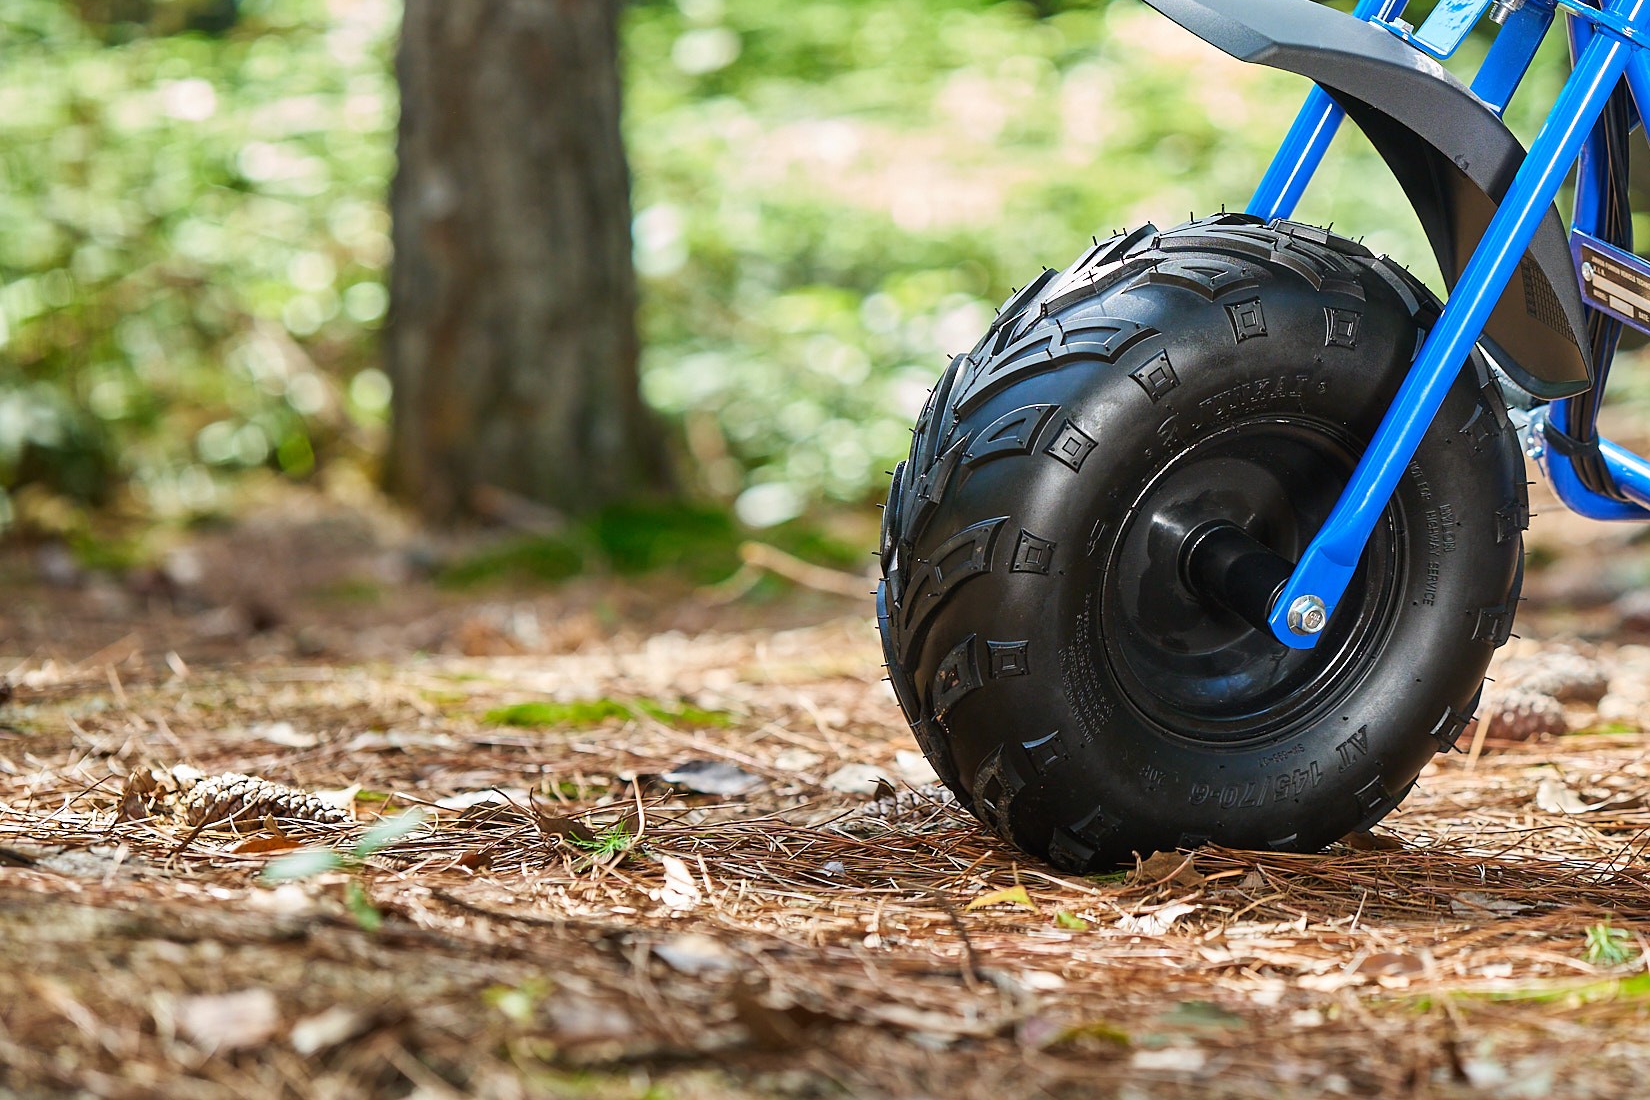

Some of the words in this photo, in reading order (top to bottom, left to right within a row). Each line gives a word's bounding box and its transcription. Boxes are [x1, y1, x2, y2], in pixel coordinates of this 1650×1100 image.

[1425, 510, 1441, 557] HIGHWAY
[1422, 561, 1440, 607] SERVICE
[1334, 723, 1369, 774] AT
[1188, 760, 1324, 810] 145/70-6
